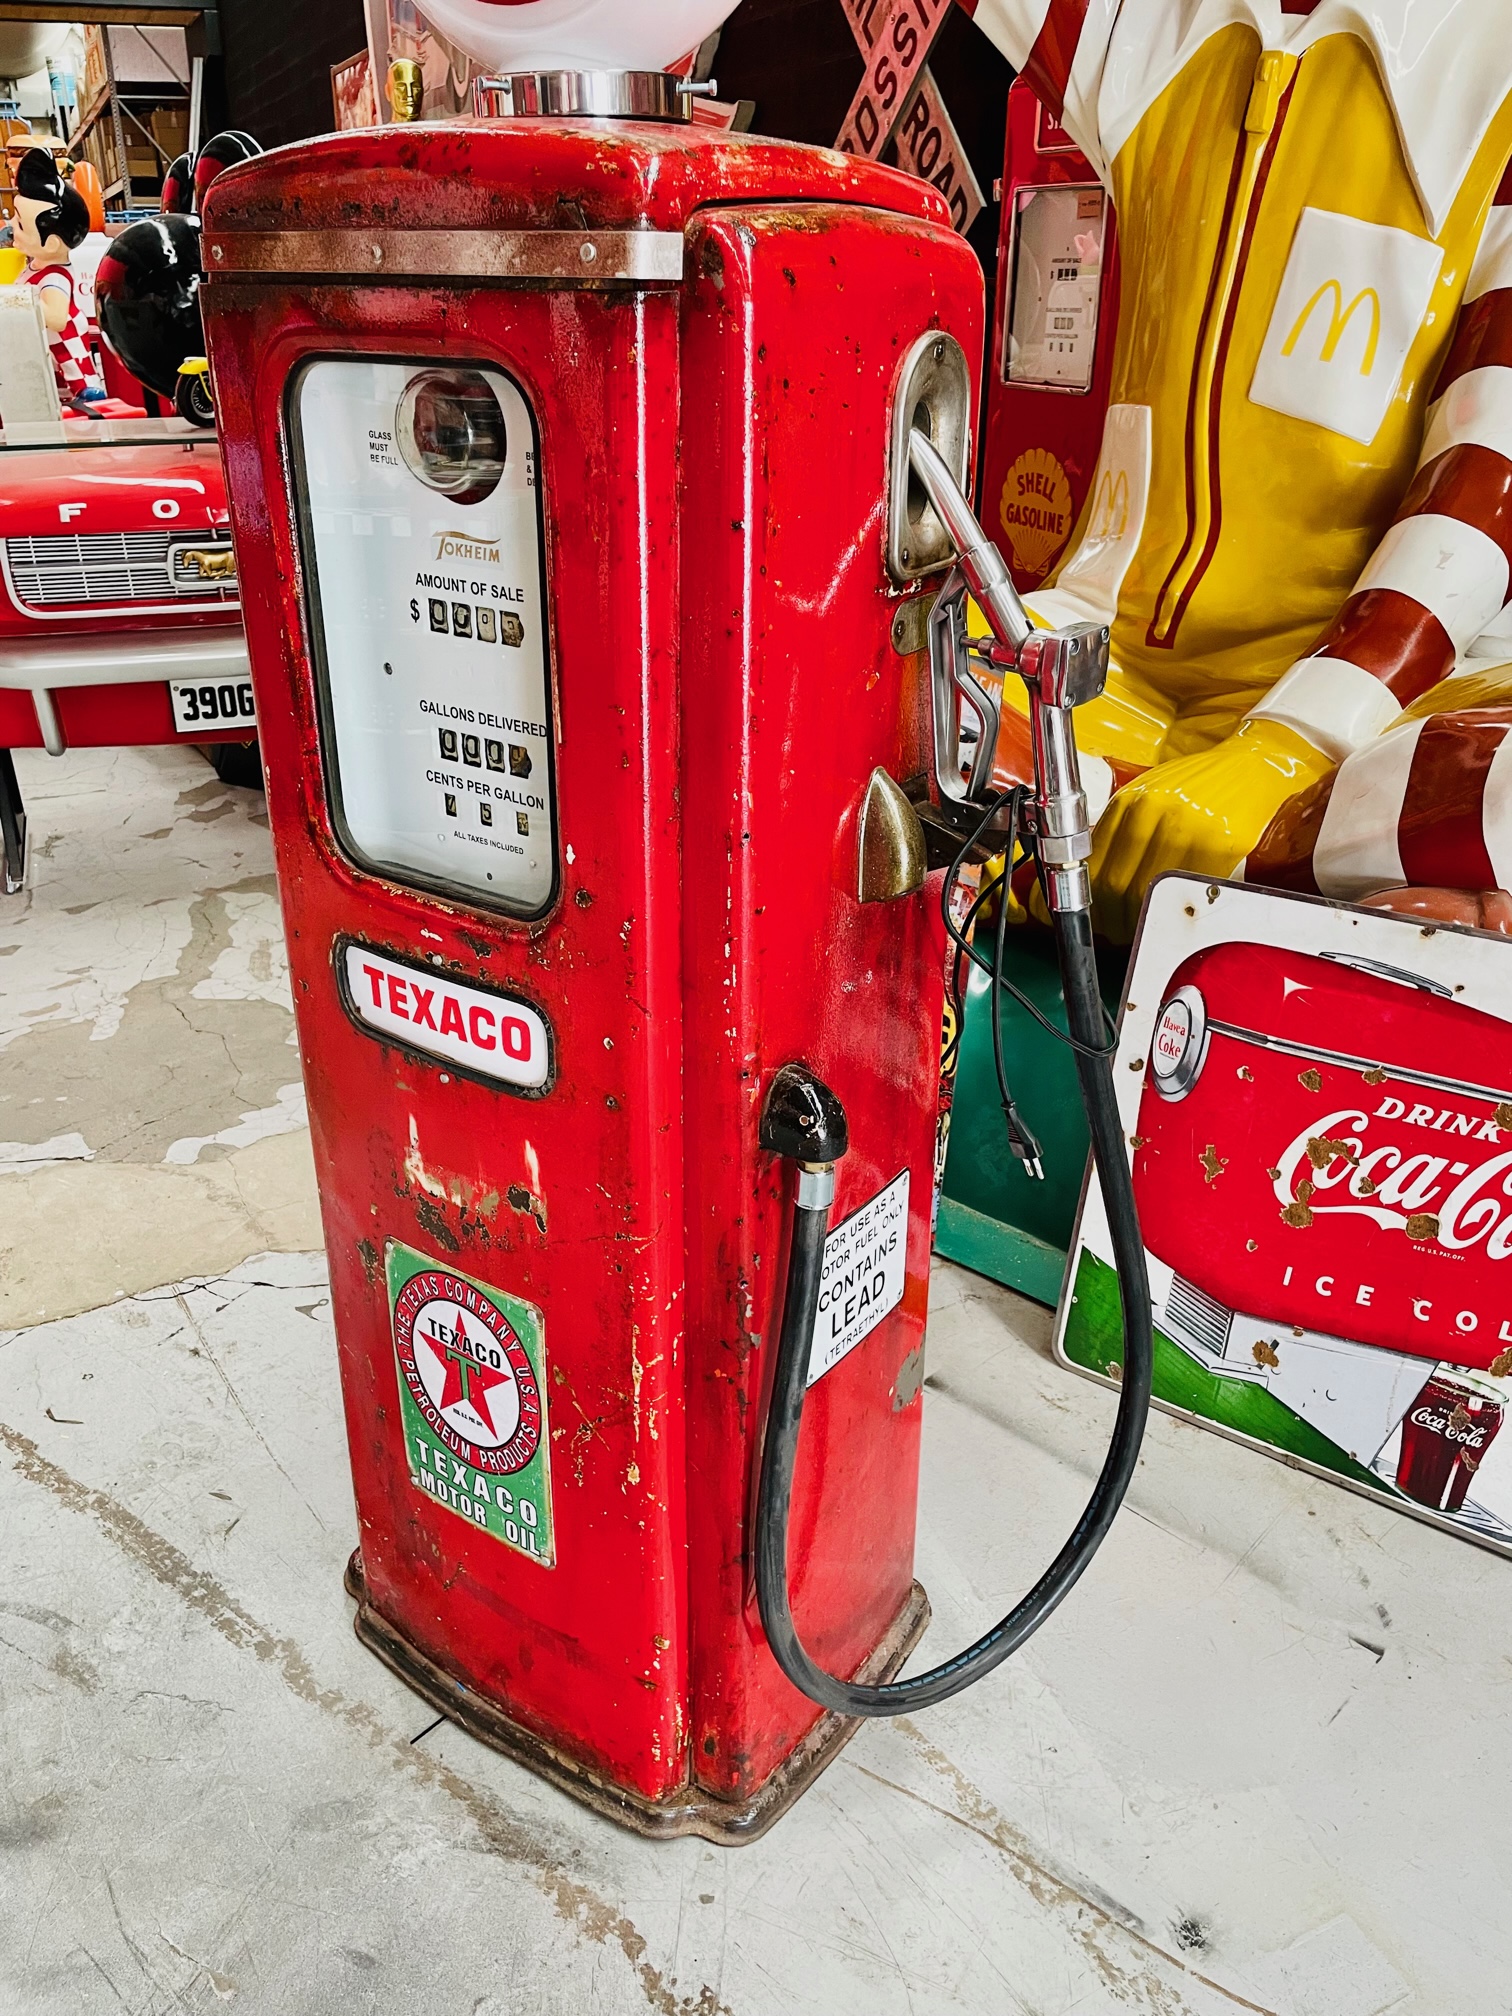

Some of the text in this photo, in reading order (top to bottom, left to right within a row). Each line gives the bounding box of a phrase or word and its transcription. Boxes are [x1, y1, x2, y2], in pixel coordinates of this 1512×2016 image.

[841, 0, 940, 154] OSSI
[368, 430, 392, 441] GLASS
[369, 442, 388, 452] MUST
[370, 454, 398, 466] BE FULL
[1017, 472, 1056, 503] SHELL
[1006, 502, 1064, 535] GASOLINE
[432, 530, 502, 563] TOKHEIM
[415, 572, 525, 603] AMOUNT OF SALE
[410, 598, 420, 623] $
[419, 699, 547, 738] GALLONS DELIVERED
[426, 769, 544, 811] CENTS PER GALLON
[453, 830, 524, 855] ALL TAXES INCLUDED
[363, 963, 532, 1063] TEXACO
[1158, 1033, 1181, 1058] Coke
[1372, 1096, 1501, 1143] DRINK
[821, 1200, 905, 1280] OTOR FUEL ONLY
[825, 1191, 896, 1258] FOR USE AS A
[819, 1231, 897, 1313] CONTAINS
[1282, 1266, 1375, 1306] ICE
[401, 1275, 439, 1313] TEXAS
[831, 1270, 886, 1339] LEAD
[396, 1311, 411, 1348] THE
[444, 1278, 520, 1353] COMPANY
[1411, 1299, 1512, 1342] COL
[427, 1316, 501, 1370] TEXACO
[402, 1358, 537, 1471] PETROLEUM PRODUCTS
[414, 1437, 538, 1528] TEXACO
[420, 1467, 540, 1556] MOTOR OIL
